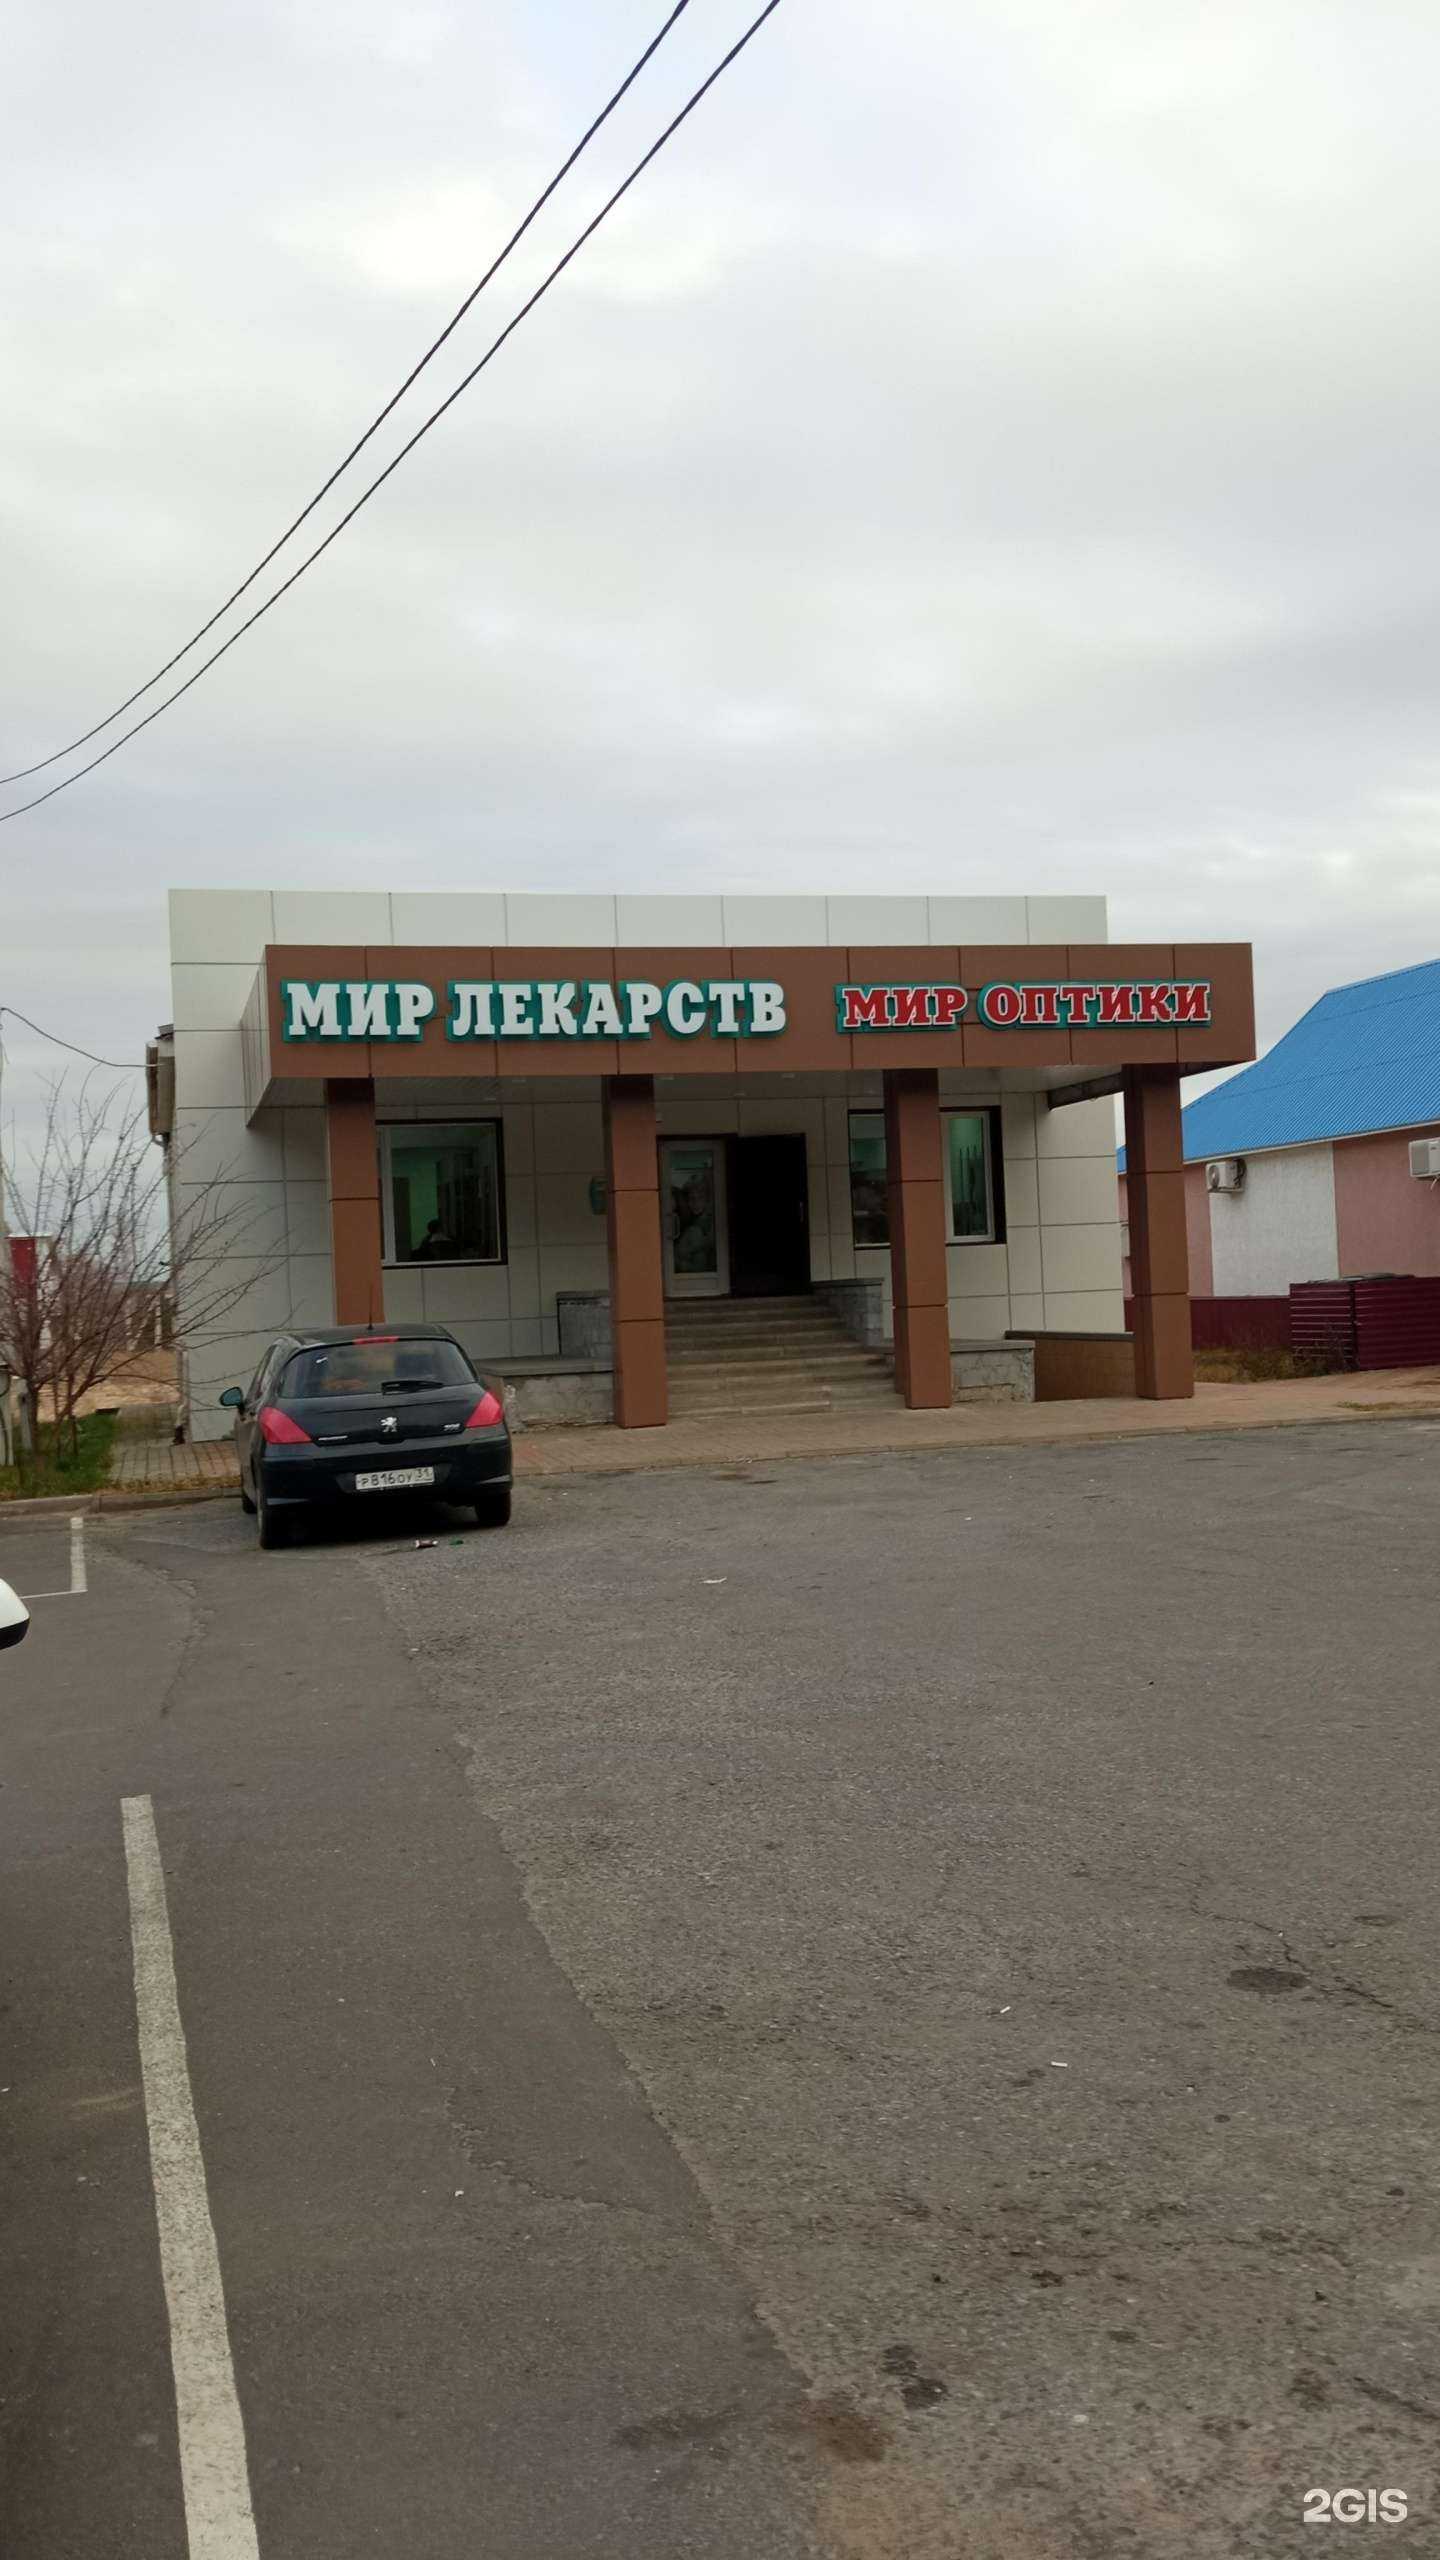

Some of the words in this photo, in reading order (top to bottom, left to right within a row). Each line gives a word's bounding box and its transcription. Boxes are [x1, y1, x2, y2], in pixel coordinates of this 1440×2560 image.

[287, 982, 434, 1036] МИР
[452, 981, 786, 1037] ЛЕКАРСТВ
[841, 986, 968, 1028] МИР
[983, 983, 1211, 1025] ОПТИКИ
